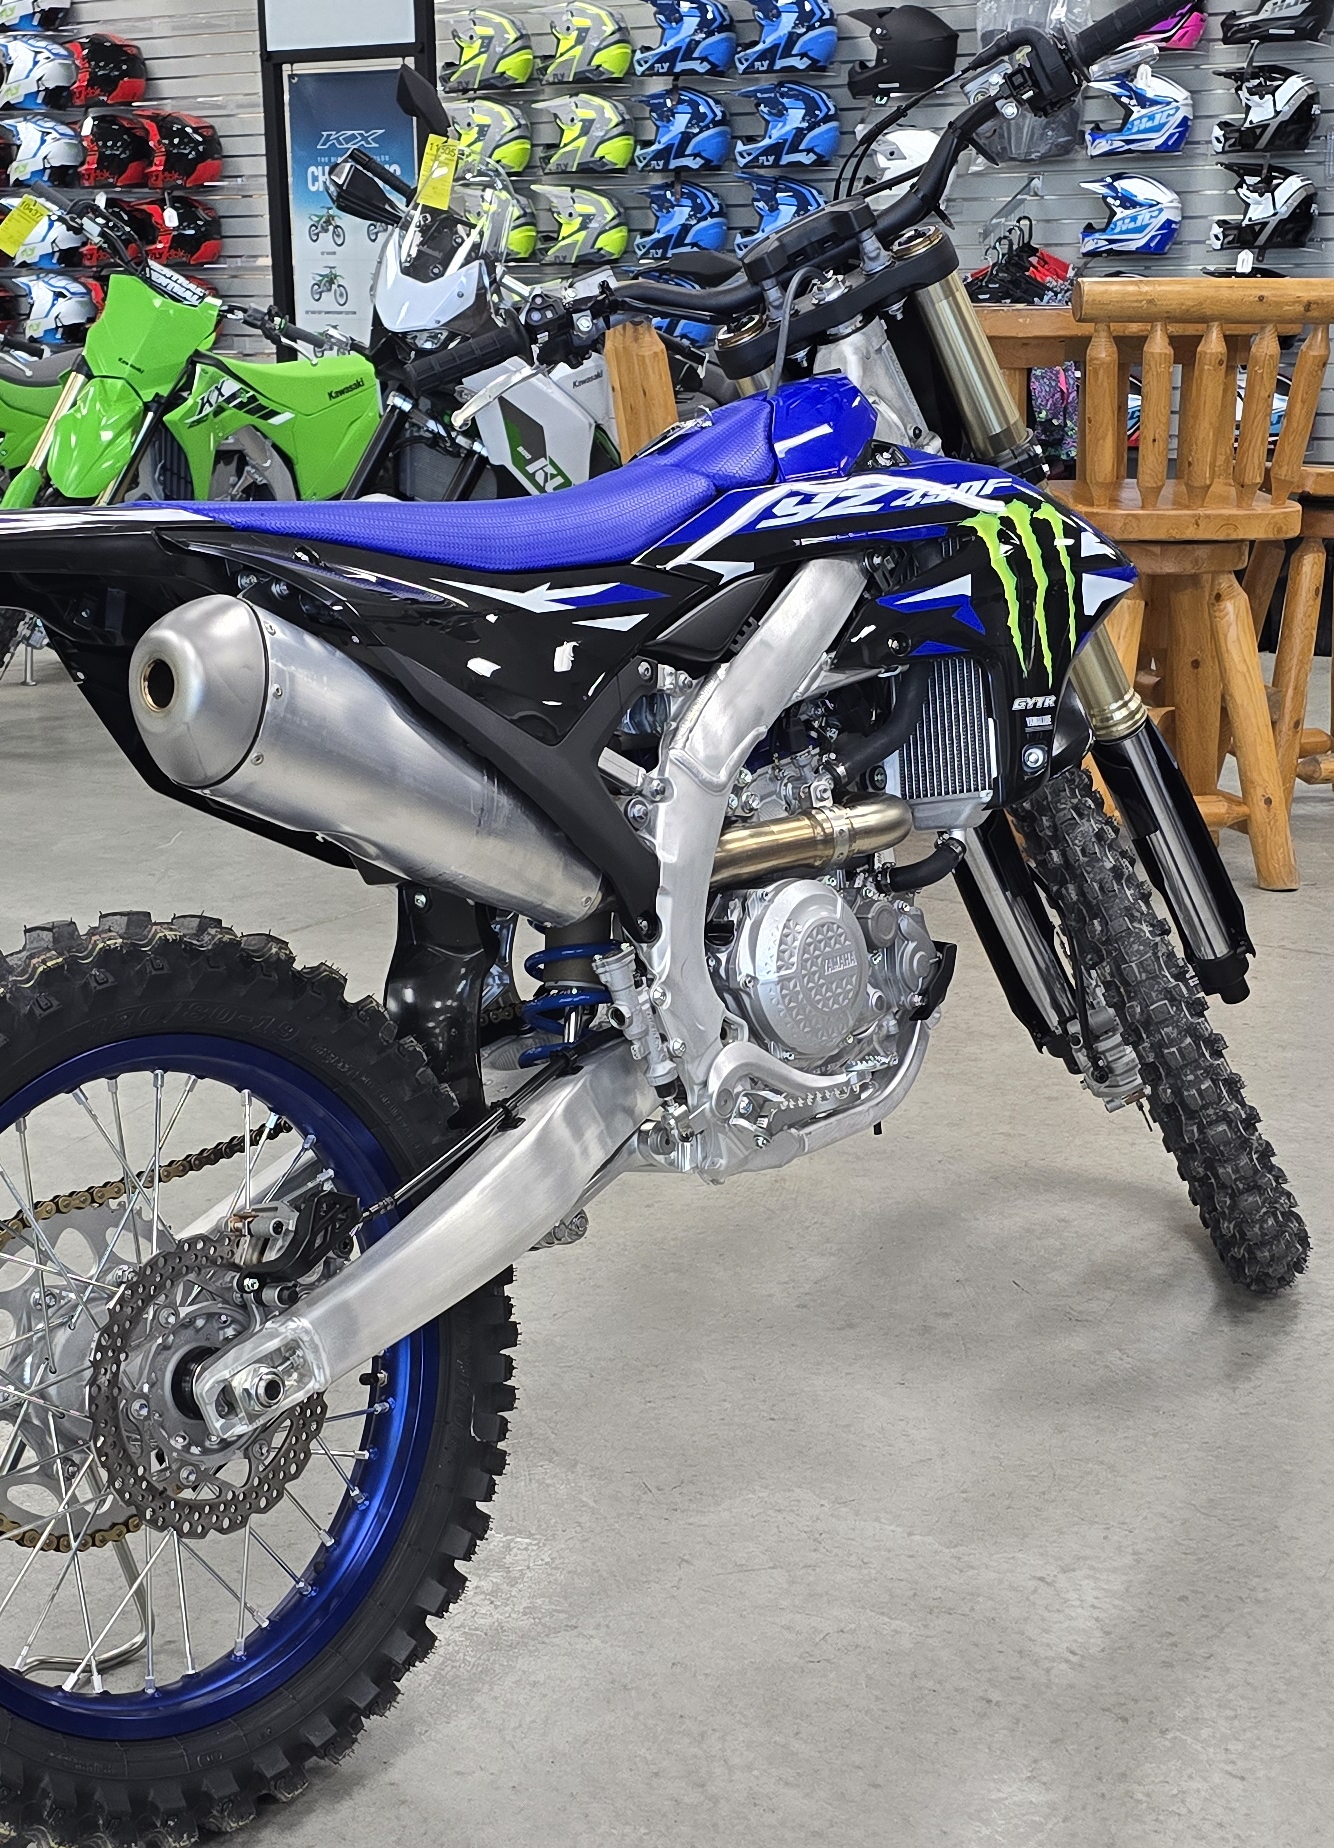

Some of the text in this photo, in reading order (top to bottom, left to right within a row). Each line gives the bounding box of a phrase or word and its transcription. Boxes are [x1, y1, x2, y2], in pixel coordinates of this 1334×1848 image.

[654, 63, 670, 72] FLY
[754, 60, 769, 70] FLY
[1132, 108, 1179, 131] HJC
[317, 129, 385, 149] KX
[650, 160, 665, 170] FLY
[759, 156, 774, 166] FLY
[1116, 209, 1163, 233] HJC
[328, 377, 365, 401] Kawasaki
[572, 369, 604, 389] Kawasaki
[196, 379, 225, 416] KX
[1012, 695, 1057, 711] GYTR
[824, 952, 858, 975] YAMAHA
[90, 1001, 301, 1062] 120/80-19
